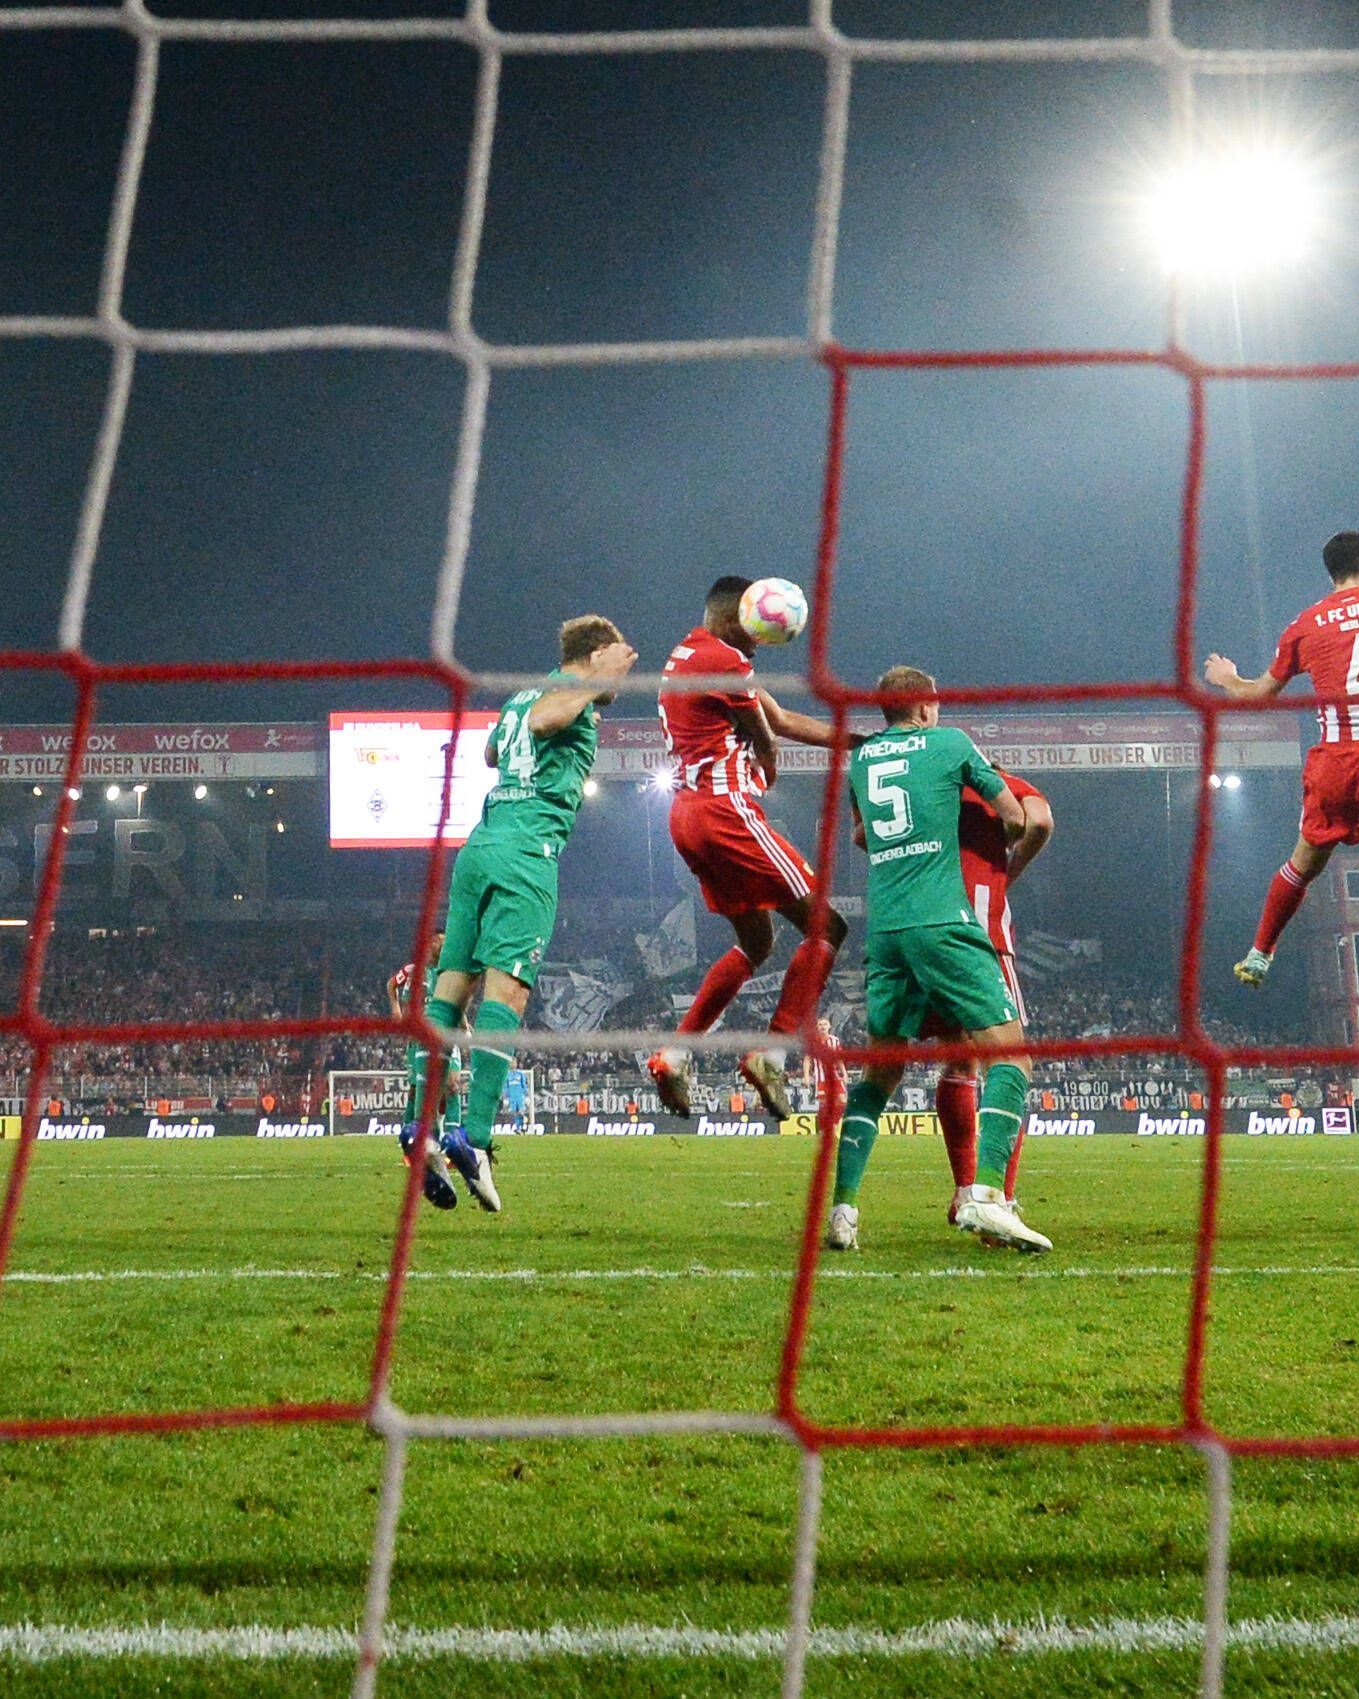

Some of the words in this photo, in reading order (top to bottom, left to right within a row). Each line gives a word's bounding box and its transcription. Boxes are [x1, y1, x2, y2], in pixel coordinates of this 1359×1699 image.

[1328, 608, 1345, 623] FC
[41, 733, 116, 751] weox
[154, 729, 230, 751] wefox
[617, 728, 662, 743] Seege
[81, 756, 134, 775] UNSER
[141, 755, 204, 775] VEREIN.
[1028, 747, 1082, 766] STOLZ.
[1090, 746, 1145, 765] UNSER
[867, 759, 914, 841] 5
[37, 1116, 106, 1140] bwin
[147, 1116, 215, 1139] bwin
[256, 1116, 326, 1138] bwin
[587, 1114, 656, 1136] bwin
[697, 1113, 766, 1136] bwin
[1027, 1111, 1096, 1136] bwin
[1137, 1110, 1206, 1136] bwin
[1247, 1108, 1316, 1135] bwin
